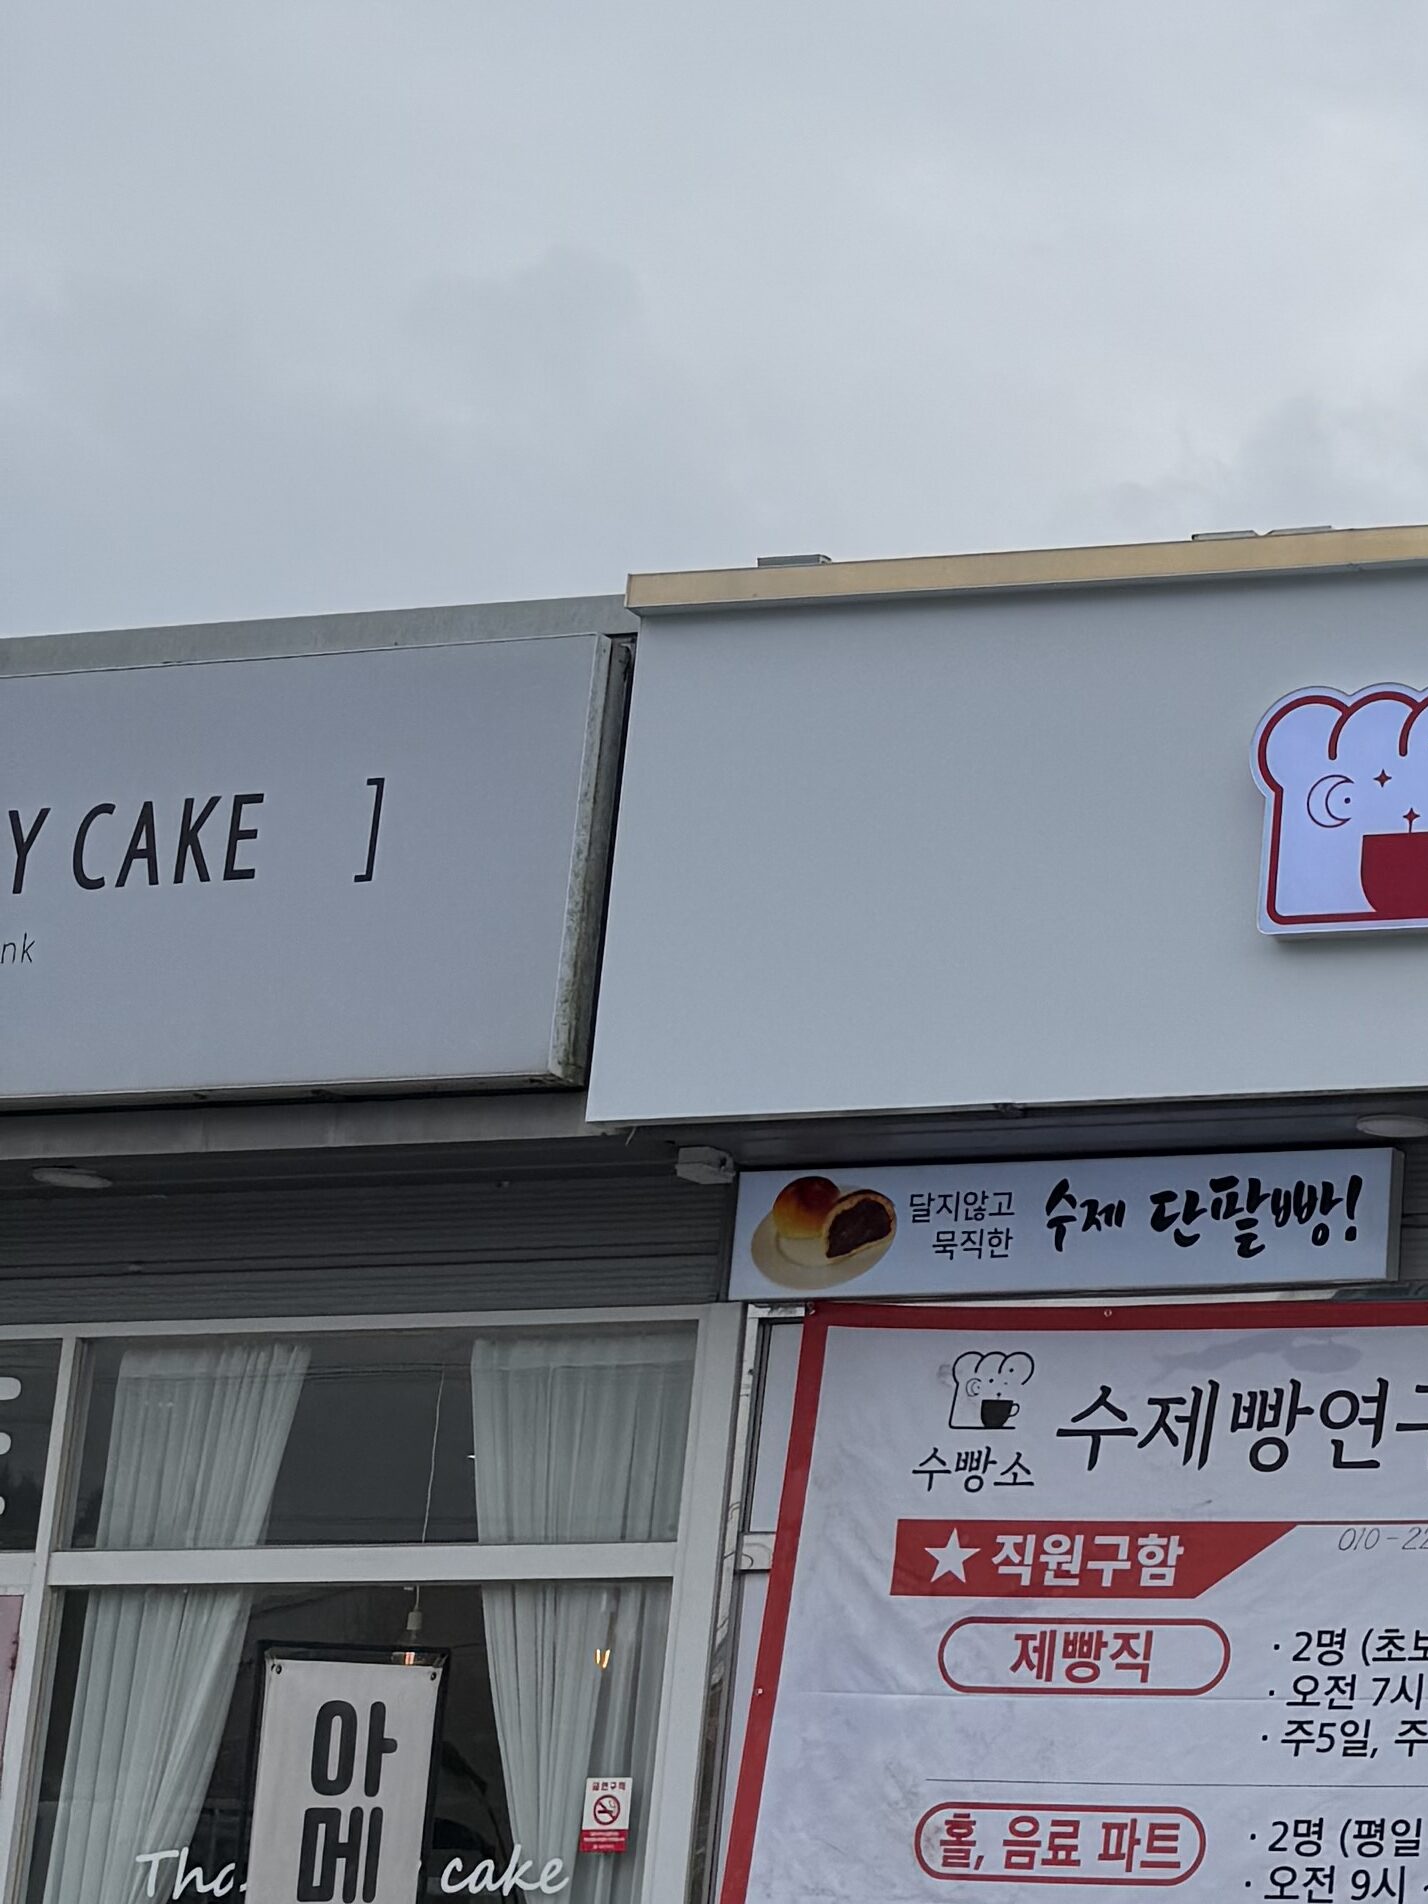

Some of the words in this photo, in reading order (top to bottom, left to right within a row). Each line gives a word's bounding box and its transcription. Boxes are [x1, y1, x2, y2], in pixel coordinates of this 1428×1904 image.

[73, 793, 264, 890] CAKE
[910, 1191, 1014, 1223] 달지않고
[1046, 1179, 1125, 1252] 수제
[932, 1228, 1013, 1260] 묵직한
[912, 1446, 1034, 1492] 수빵소
[992, 1534, 1184, 1586] 직원구함
[1009, 1629, 1154, 1684] 제빵직
[1293, 1628, 1346, 1666] 2명
[1286, 1674, 1356, 1709] 오전
[1372, 1673, 1423, 1710] 7시
[1281, 1719, 1377, 1758] 주5일,
[939, 1811, 985, 1871] 홀,
[1002, 1814, 1081, 1869] 음료
[1097, 1816, 1182, 1873] 파트
[1269, 1818, 1323, 1857] 2명
[1340, 1818, 1421, 1858] (평일
[440, 1844, 570, 1897] cake
[1264, 1865, 1335, 1903] 오전
[1351, 1866, 1405, 1904] 9시
